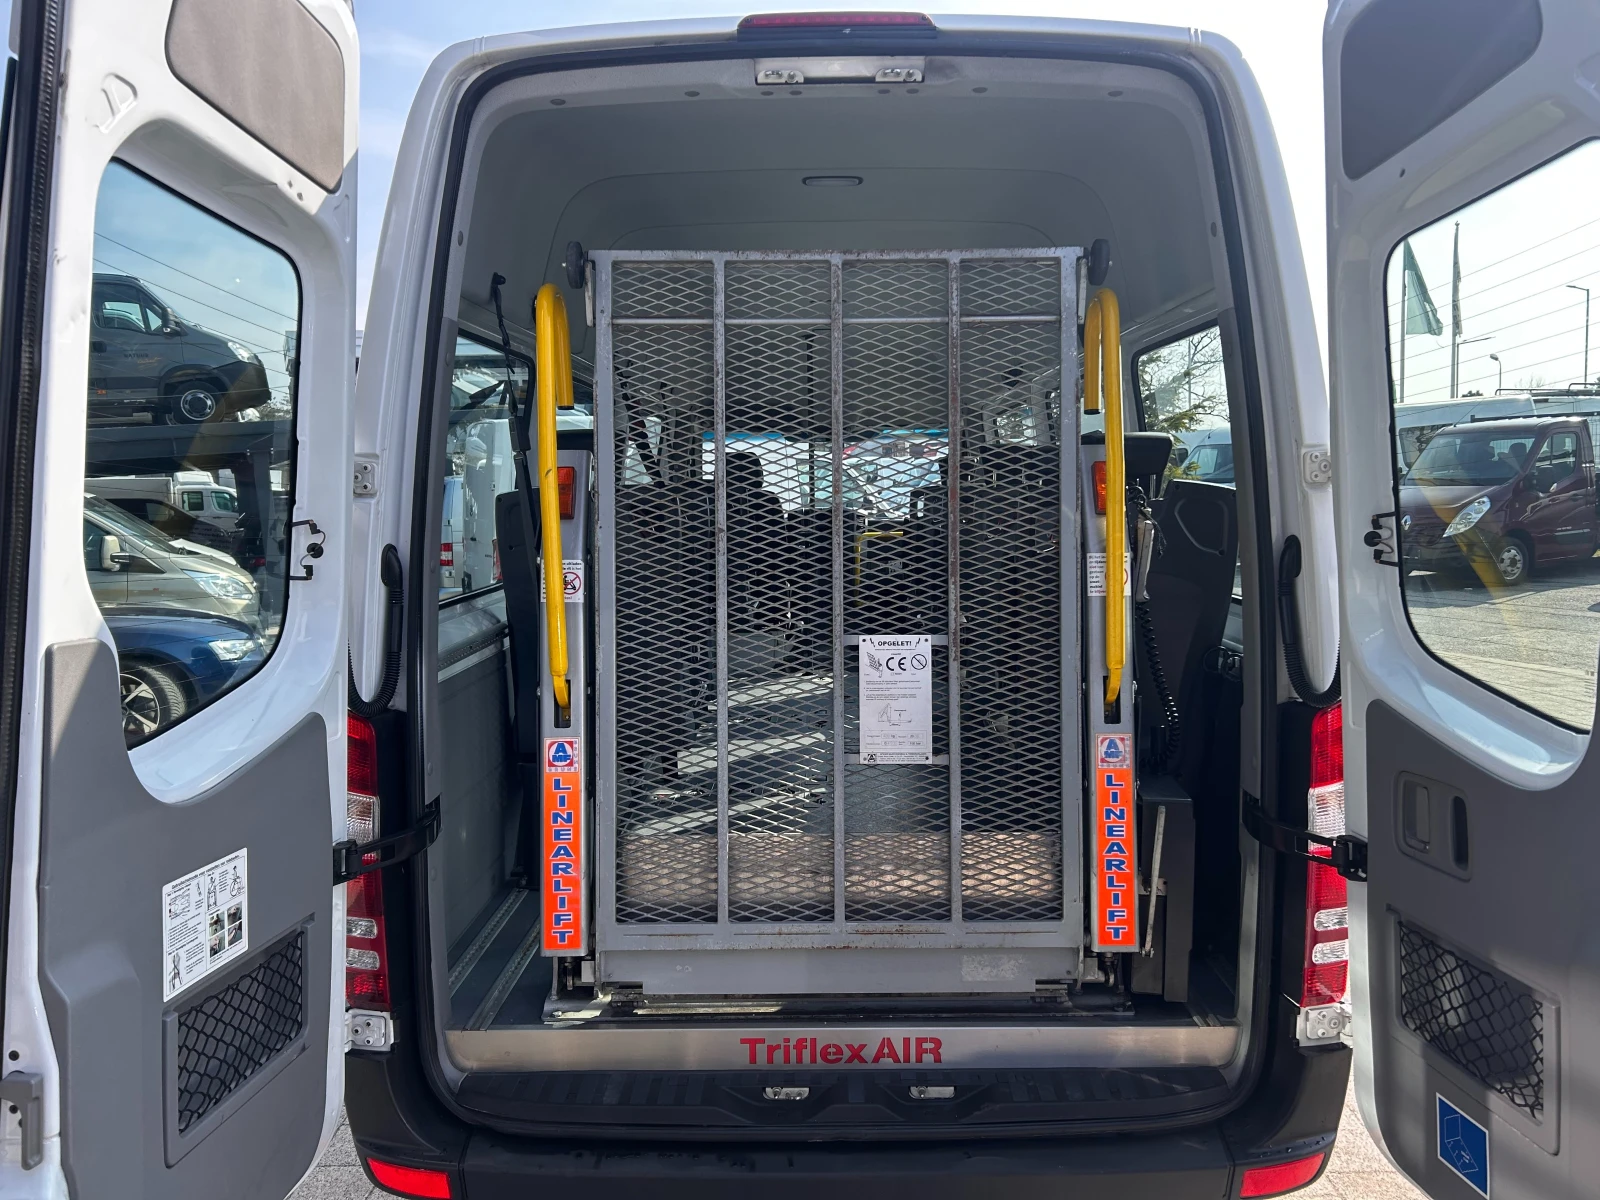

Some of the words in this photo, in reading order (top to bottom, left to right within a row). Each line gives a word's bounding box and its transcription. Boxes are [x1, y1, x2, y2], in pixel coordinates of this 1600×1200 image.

[886, 656, 907, 672] CE
[550, 776, 577, 945] LINEARLIFT
[1102, 773, 1130, 941] LINEARLIFT
